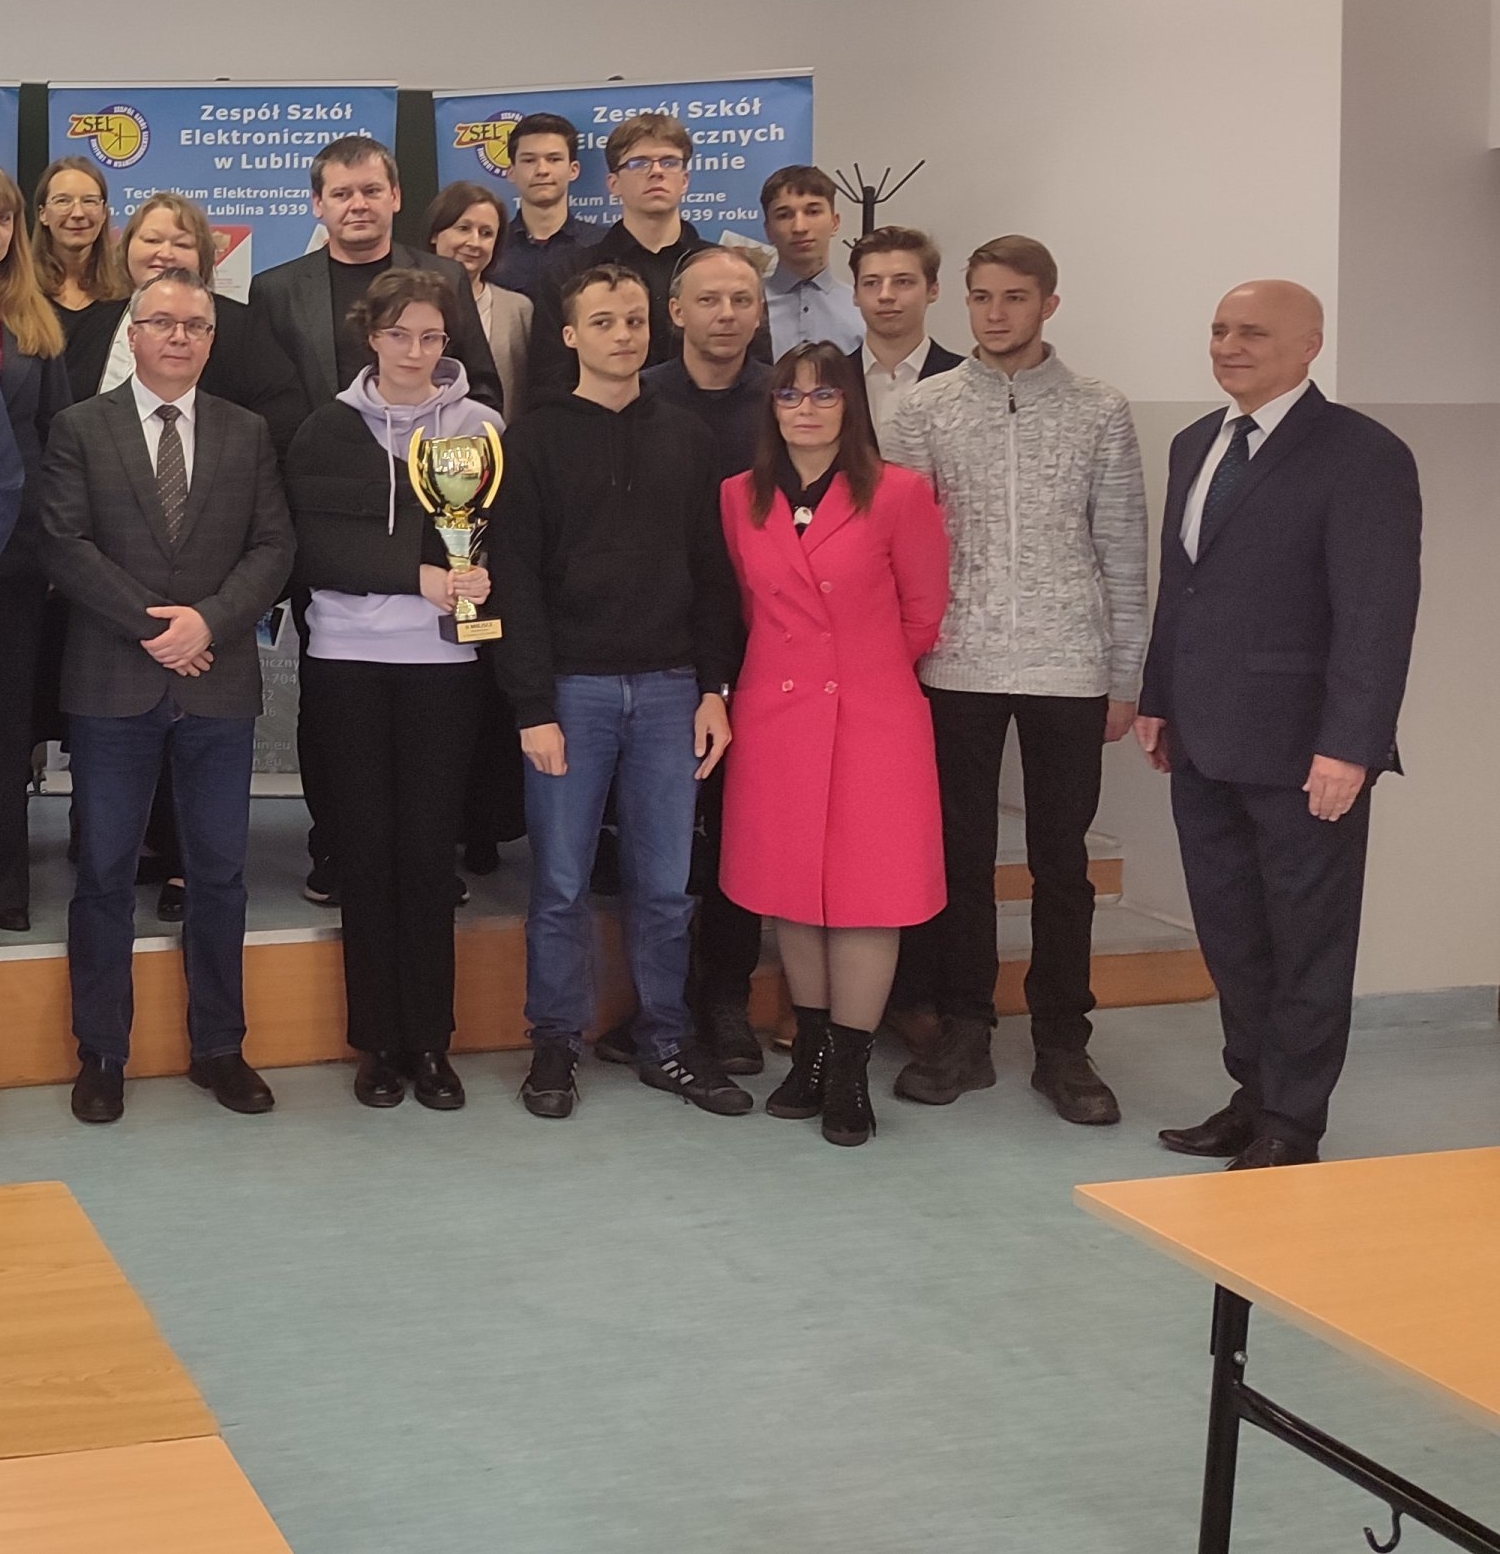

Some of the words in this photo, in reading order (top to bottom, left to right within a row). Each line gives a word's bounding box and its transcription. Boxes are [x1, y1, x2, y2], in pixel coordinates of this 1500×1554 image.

[200, 103, 280, 124] Zespół
[287, 102, 352, 120] Szkół
[688, 97, 762, 118] Szkół
[69, 116, 114, 136] ZSEL
[456, 123, 502, 146] ZSEL
[214, 157, 233, 169] w
[241, 153, 314, 169] Lublin
[213, 187, 310, 199] Elektroniczn
[207, 204, 264, 216] Lublina
[269, 204, 308, 216] 1939
[681, 208, 713, 221] 939
[719, 207, 758, 220] roku
